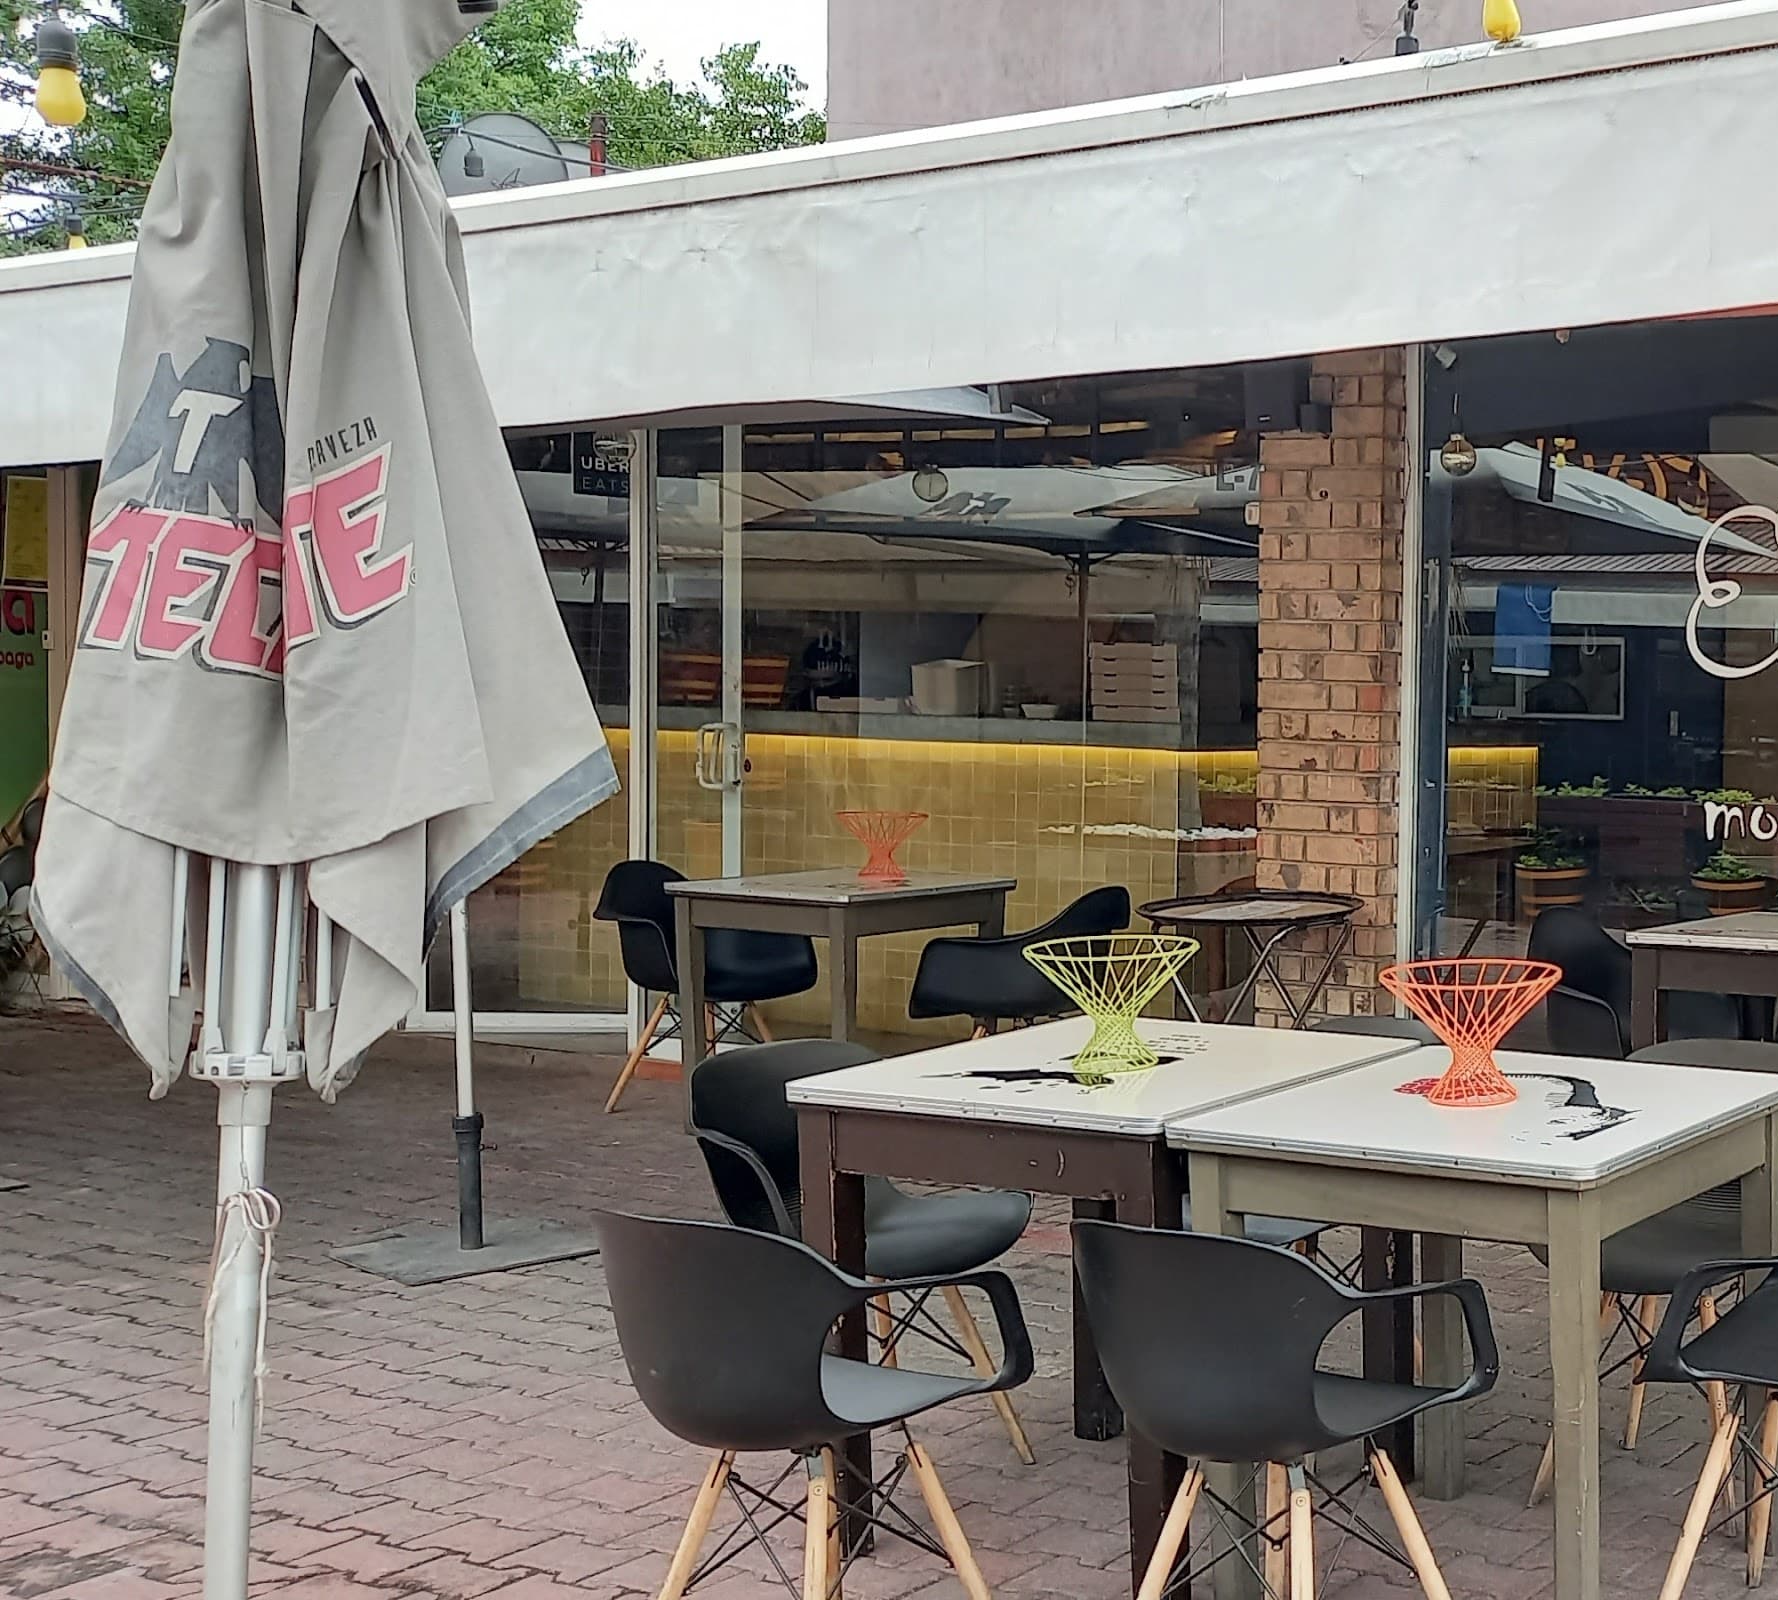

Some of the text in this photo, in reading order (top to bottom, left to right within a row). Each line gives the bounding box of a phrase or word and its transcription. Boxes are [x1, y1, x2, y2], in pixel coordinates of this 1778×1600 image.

[581, 456, 629, 473] UBER
[582, 477, 629, 494] EATS
[78, 441, 416, 682] TECTE
